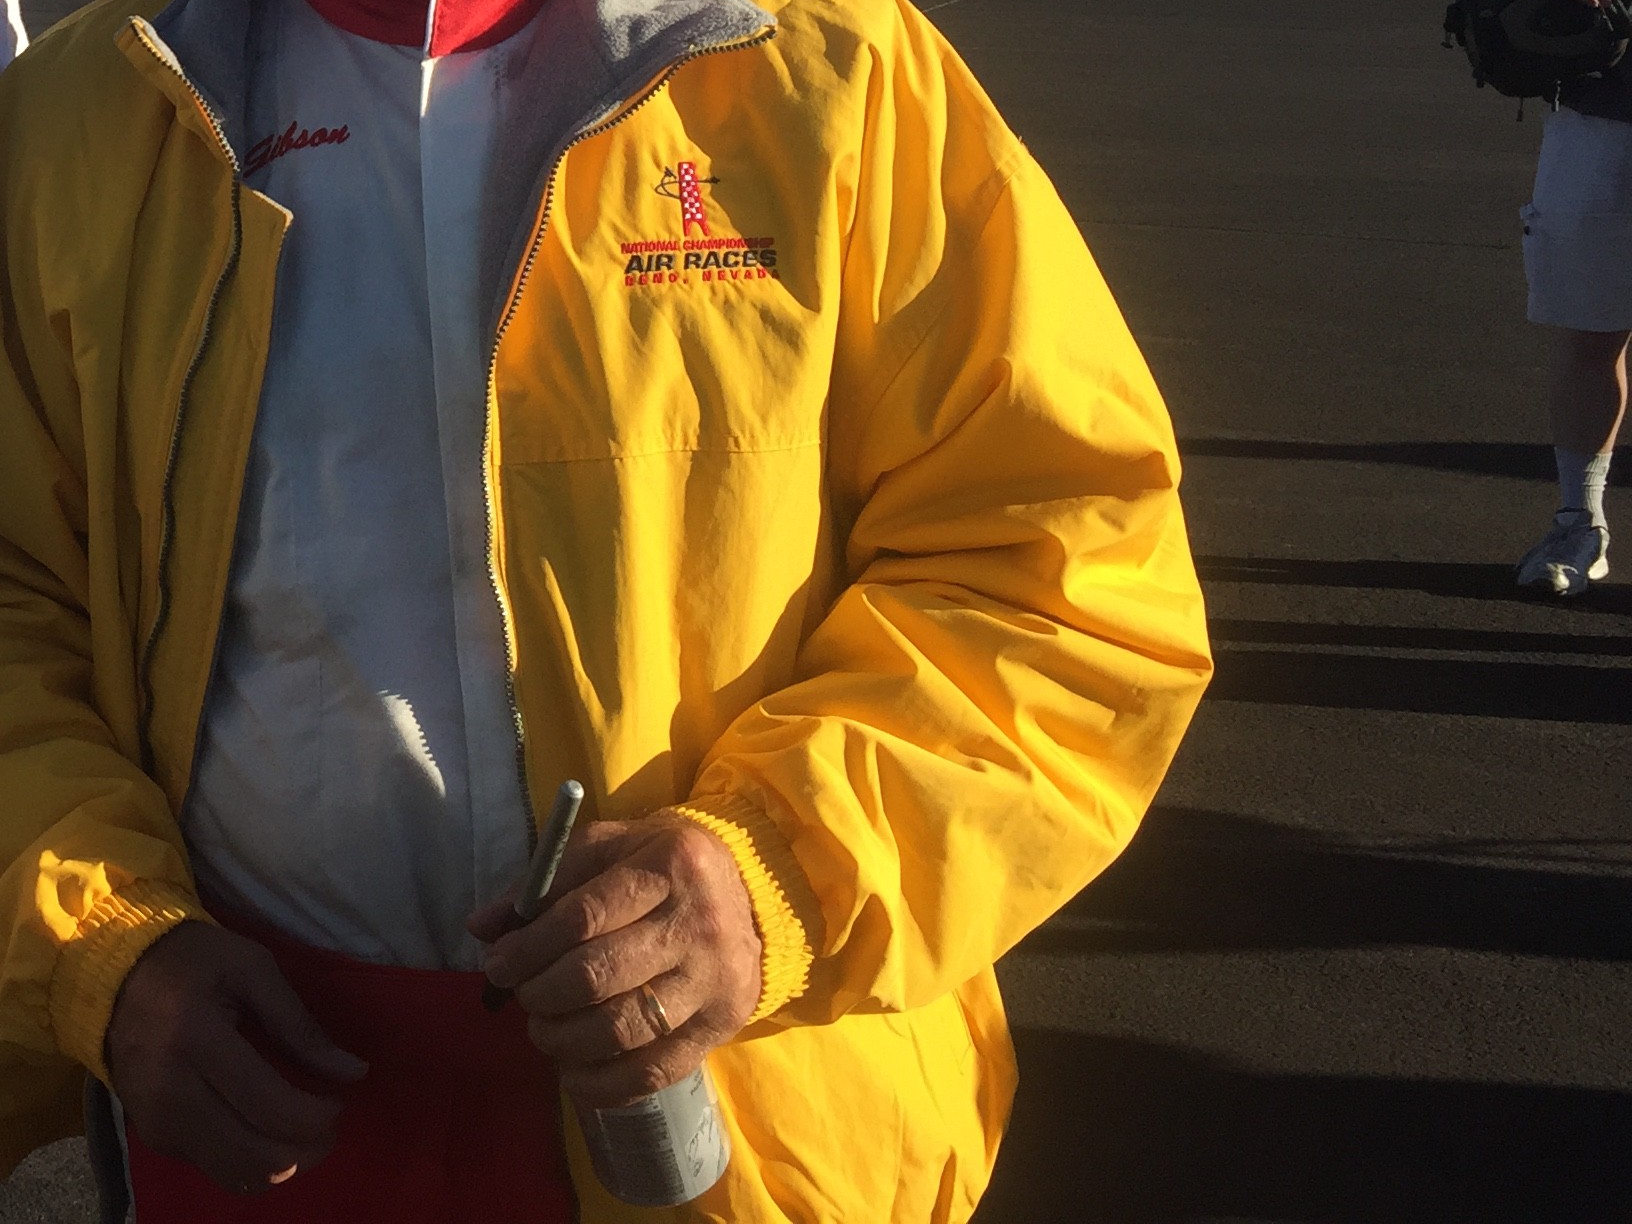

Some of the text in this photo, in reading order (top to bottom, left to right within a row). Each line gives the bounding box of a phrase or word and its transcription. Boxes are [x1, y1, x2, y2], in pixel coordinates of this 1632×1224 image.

[621, 240, 679, 255] NATIONAL
[624, 249, 778, 275] AIR RACES
[702, 268, 781, 282] NEVADA
